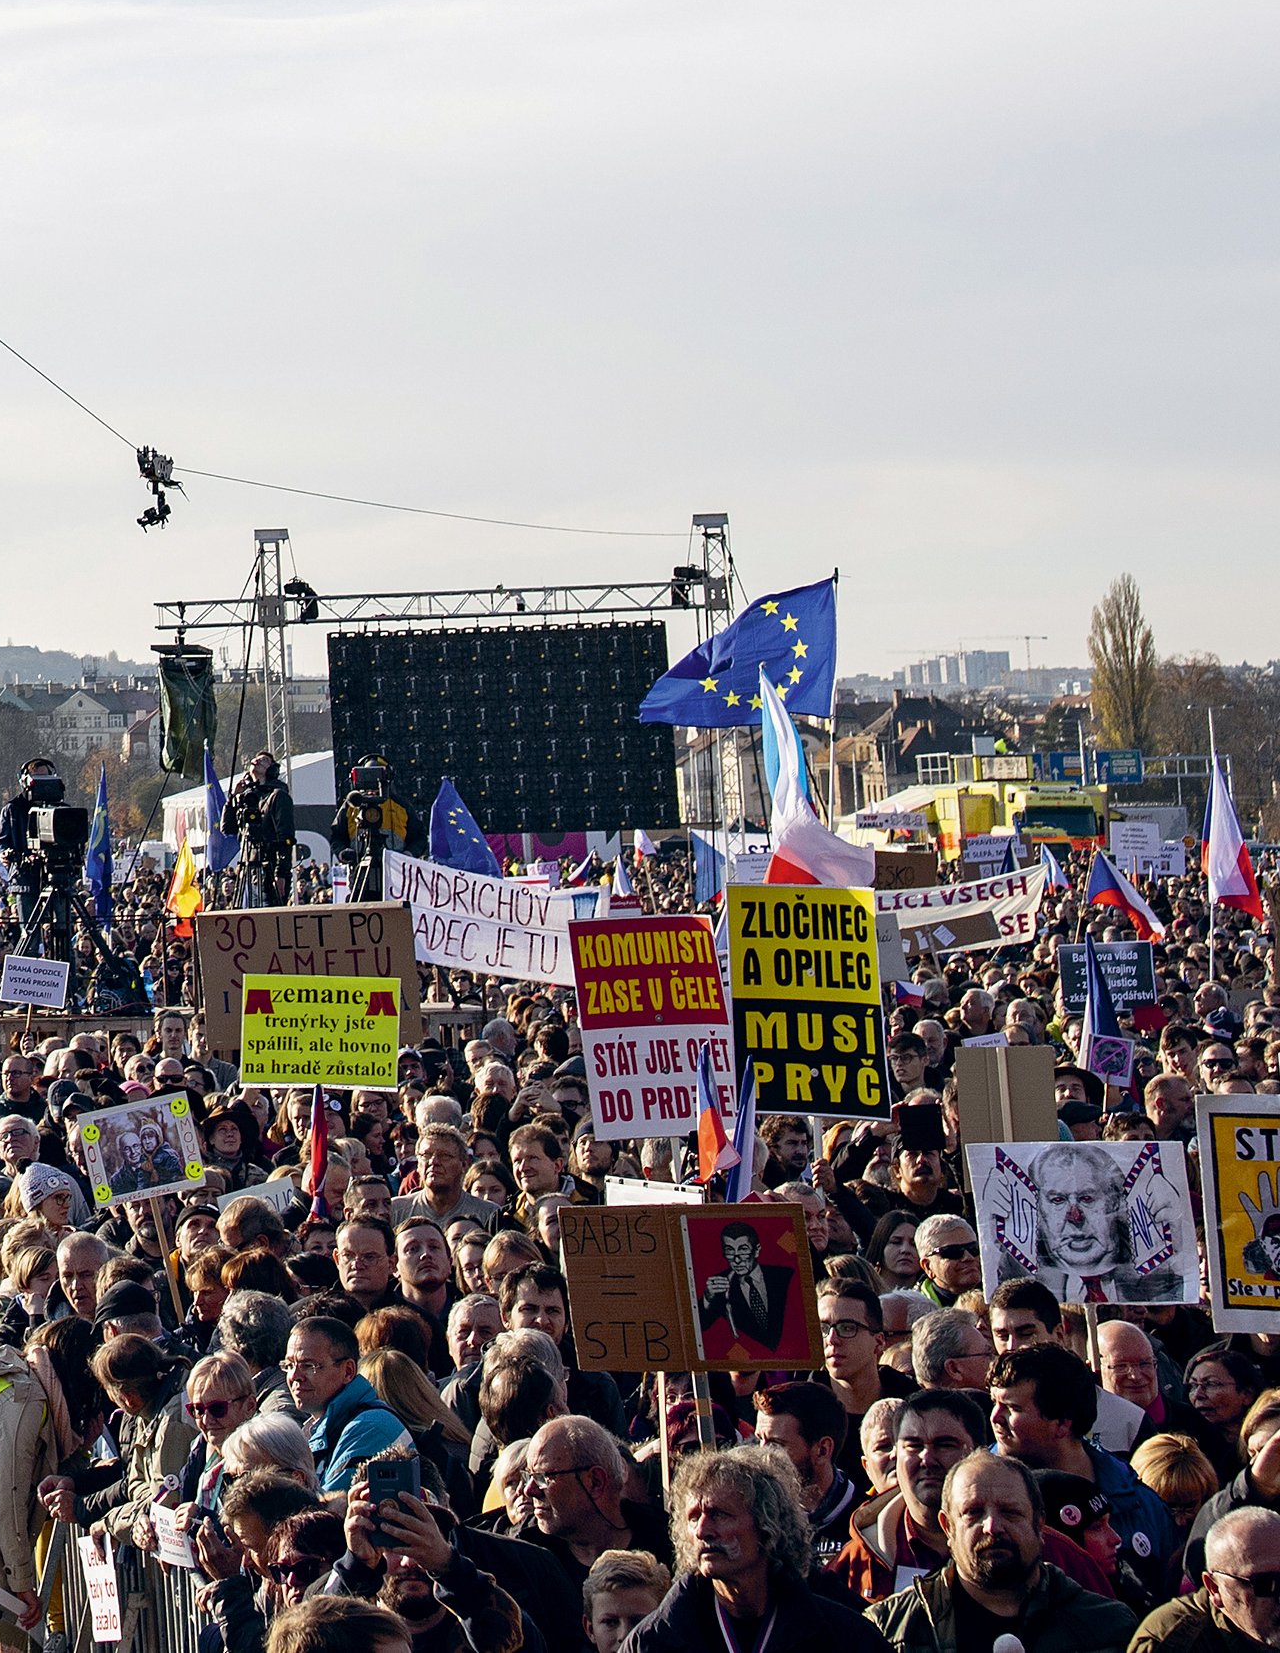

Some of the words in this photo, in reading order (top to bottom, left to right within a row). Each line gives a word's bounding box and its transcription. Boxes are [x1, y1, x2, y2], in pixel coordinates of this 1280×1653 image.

[390, 862, 551, 927] JINDŘICHŮV
[215, 915, 257, 952] 30
[275, 914, 332, 950] LET
[349, 912, 383, 945] PO
[741, 894, 868, 943] ZLOČINEC
[414, 913, 480, 963] ADEC
[486, 926, 515, 969] JE
[524, 931, 559, 975] TU
[578, 930, 713, 969] KOMUNISTI
[1114, 950, 1139, 961] vláda
[8, 963, 32, 974] DRAHÁ
[33, 966, 64, 978] OPOZICE,
[32, 978, 60, 988] PROSÍM
[743, 948, 762, 986] A
[774, 948, 872, 991] OPILEC
[1107, 964, 1137, 977] krajiny
[1108, 978, 1138, 989] justice
[272, 987, 369, 1007] zemane,
[585, 978, 643, 1015] ZASE
[647, 977, 664, 1011] V
[670, 969, 720, 1011] ČELE
[1112, 989, 1154, 1004] podářství
[265, 1014, 339, 1033] trenýrky
[344, 1015, 375, 1033] jste
[745, 1008, 876, 1055] MUSÍ
[247, 1036, 304, 1054] spálili,
[309, 1039, 332, 1053] ale
[340, 1038, 391, 1054] hovno
[593, 1034, 638, 1078] STÁT
[645, 1039, 683, 1075] JDE
[687, 1030, 730, 1073] OĚT
[244, 1062, 265, 1074] na
[271, 1059, 321, 1075] hradě
[326, 1060, 393, 1077] zůstalo!
[752, 1058, 881, 1106] PRYČ
[599, 1088, 634, 1123] DO
[561, 1210, 657, 1256] BABIŠ
[584, 1321, 671, 1363] STB
[105, 1578, 116, 1598] to
